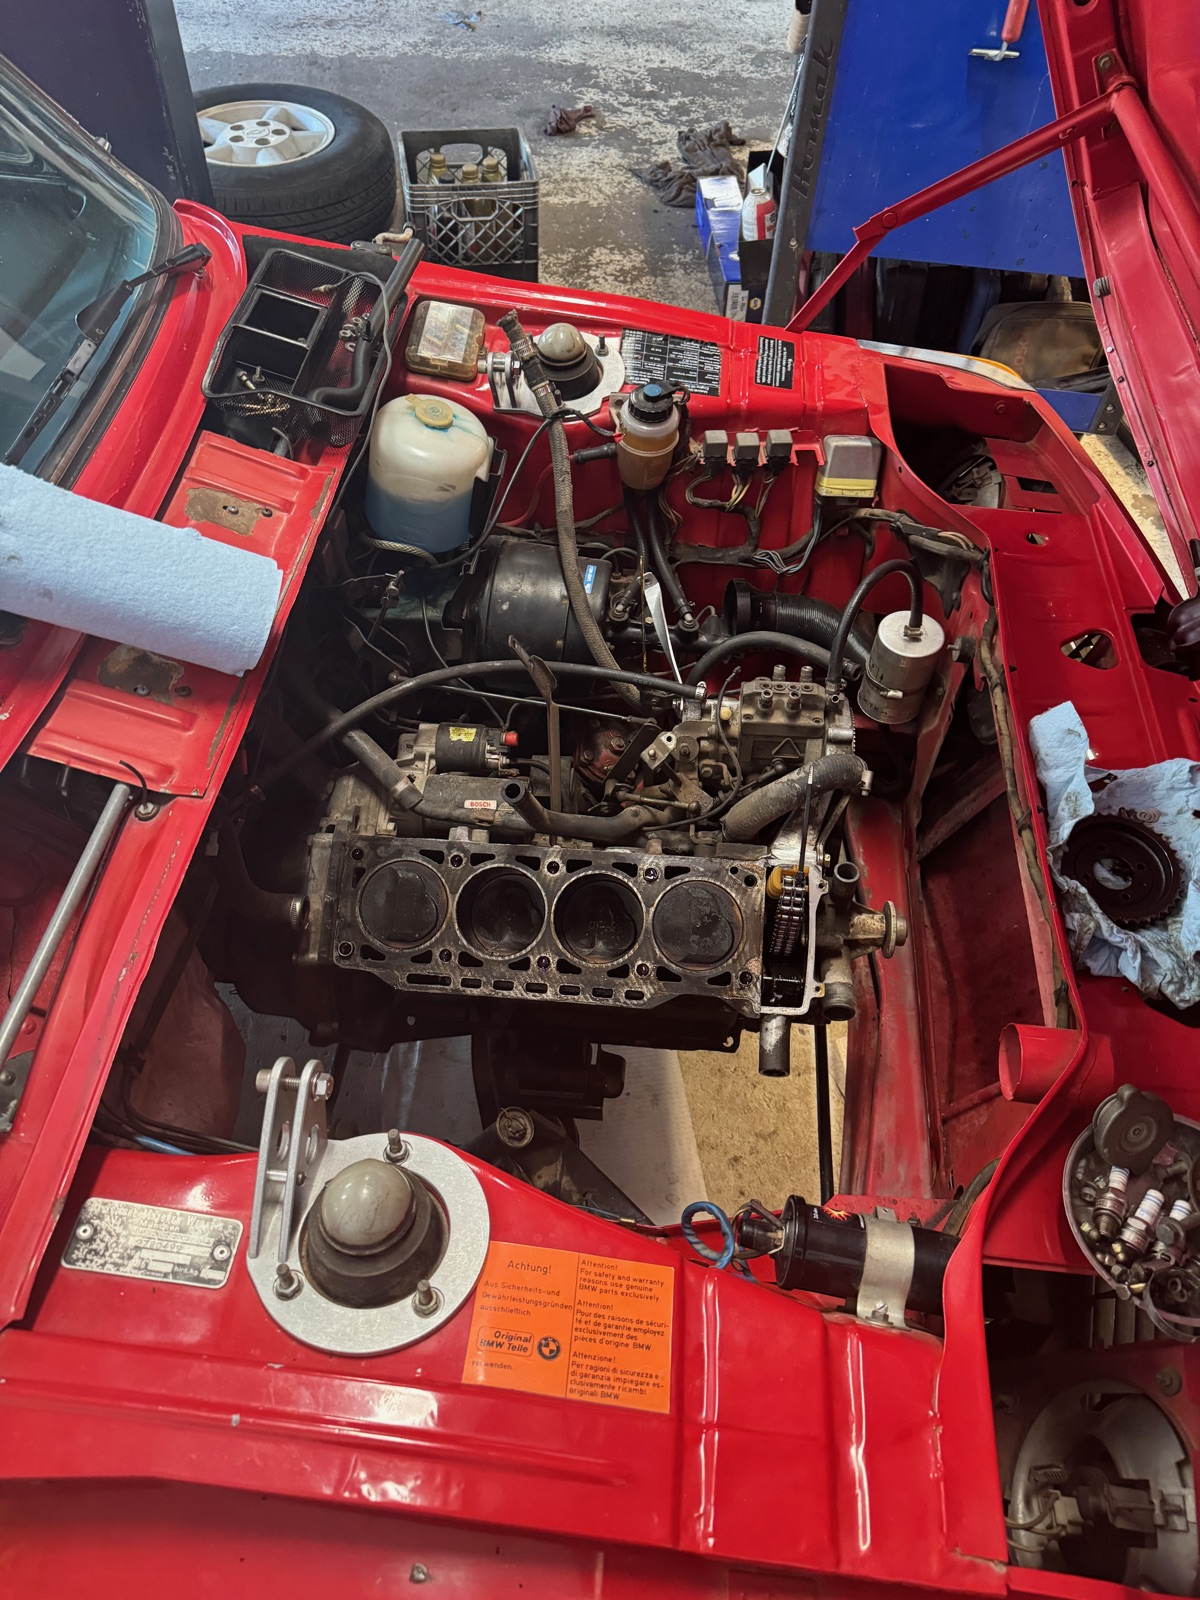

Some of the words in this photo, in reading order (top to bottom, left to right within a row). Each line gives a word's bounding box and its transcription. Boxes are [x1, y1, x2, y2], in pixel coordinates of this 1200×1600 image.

[508, 1260, 552, 1275] Achtung!
[581, 1260, 618, 1270] Attention!
[580, 1277, 607, 1286] reasons
[626, 1284, 653, 1292] genuine
[594, 1272, 615, 1280] safety
[632, 1278, 664, 1287] warranty
[480, 1305, 531, 1316] ausschließlich
[577, 1300, 614, 1310] Attention!
[576, 1309, 592, 1317] Pour
[608, 1315, 633, 1324] raisons
[646, 1319, 669, 1328] sécuri-
[575, 1327, 624, 1339] exclusivement
[603, 1322, 631, 1331] garantie
[633, 1327, 665, 1336] employez
[494, 1331, 532, 1343] Original
[574, 1335, 596, 1343] pièces
[480, 1340, 504, 1349] BMW
[507, 1343, 528, 1353] Teile
[585, 1364, 610, 1372] ragioni
[620, 1369, 653, 1379] sicurezza
[579, 1372, 611, 1381] garanzia
[613, 1376, 650, 1387] impiegare
[569, 1388, 598, 1396] originali
[570, 1379, 615, 1391] clusivamente
[618, 1386, 646, 1395] ricambi
